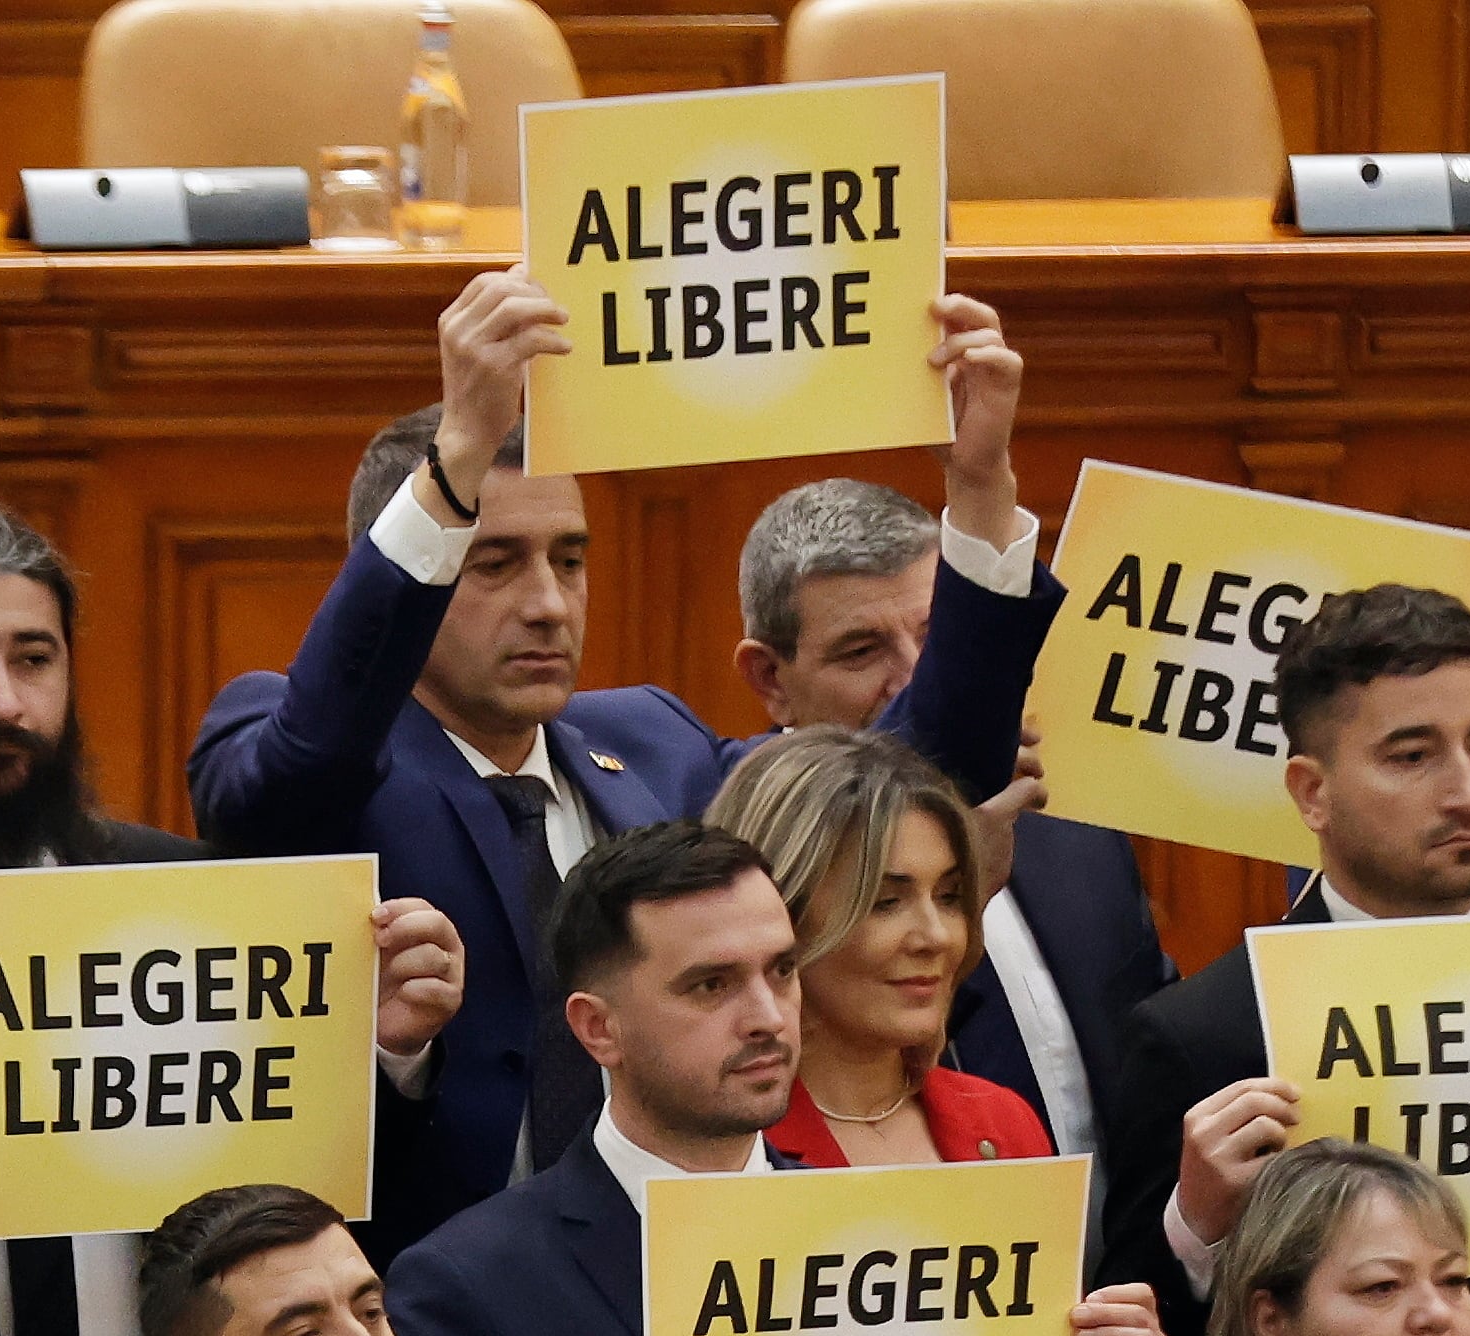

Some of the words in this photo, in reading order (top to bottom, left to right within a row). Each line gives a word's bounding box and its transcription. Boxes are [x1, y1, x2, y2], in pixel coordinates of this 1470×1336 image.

[567, 165, 902, 266] ALEGERI
[601, 271, 872, 367] LIBERE
[1085, 554, 1337, 655] ALEG
[1092, 652, 1291, 760] LIBE
[4, 1046, 296, 1136] LIBERE
